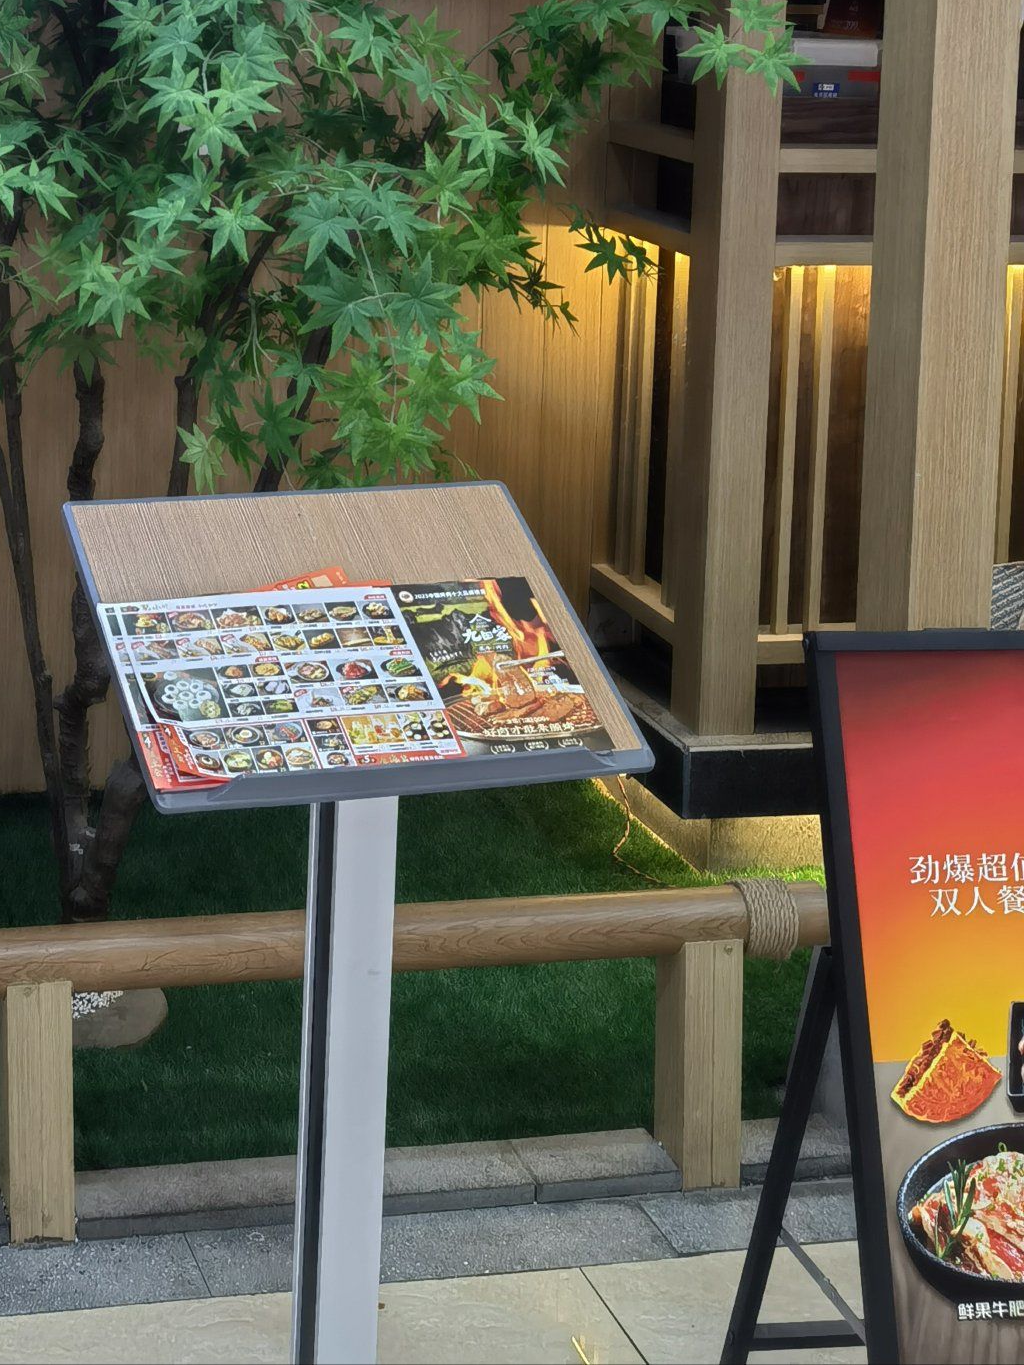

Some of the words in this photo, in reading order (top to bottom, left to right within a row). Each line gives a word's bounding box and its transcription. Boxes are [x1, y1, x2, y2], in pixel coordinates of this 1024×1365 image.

[462, 625, 513, 644] 九田家
[929, 885, 1024, 917] 双人餐
[958, 1300, 1024, 1319] 鲜果牛肥
